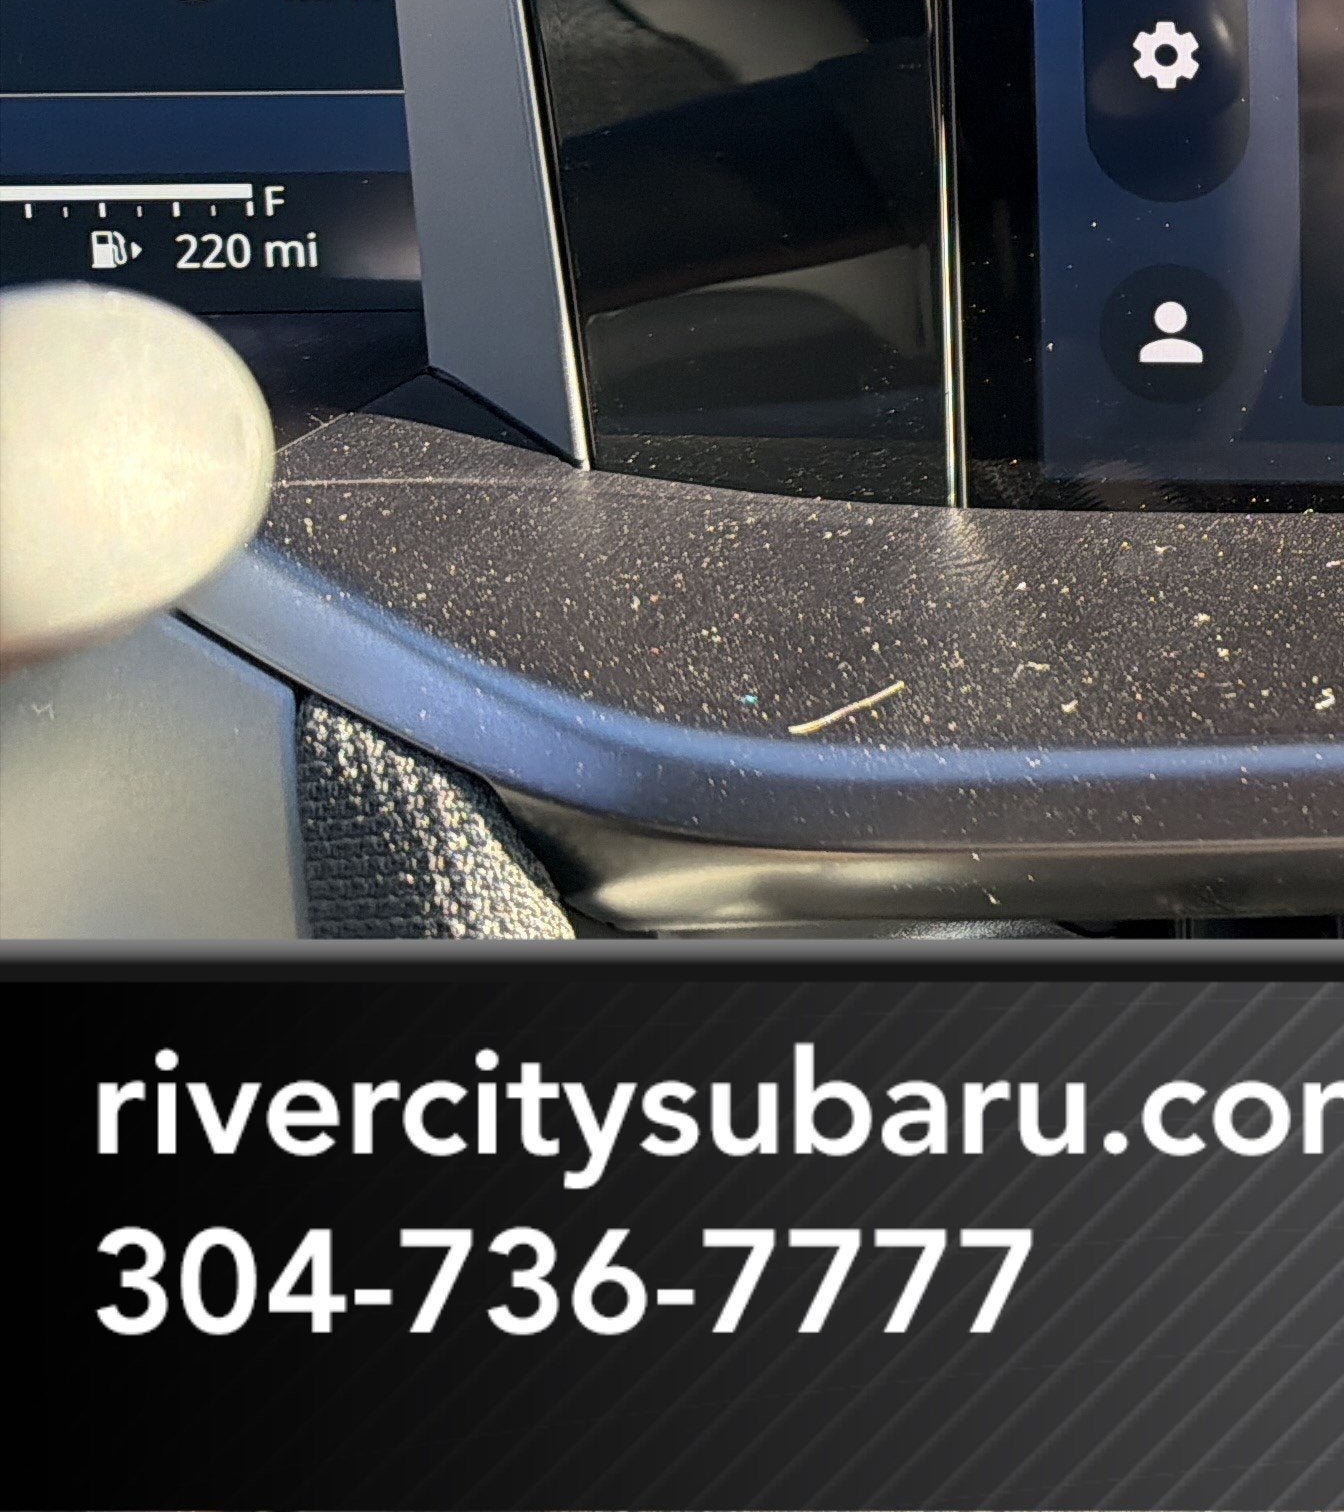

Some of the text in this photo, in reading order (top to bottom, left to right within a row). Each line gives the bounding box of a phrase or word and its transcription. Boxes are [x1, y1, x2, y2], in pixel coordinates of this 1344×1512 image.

[264, 186, 285, 216] F
[175, 232, 319, 268] 220 mi
